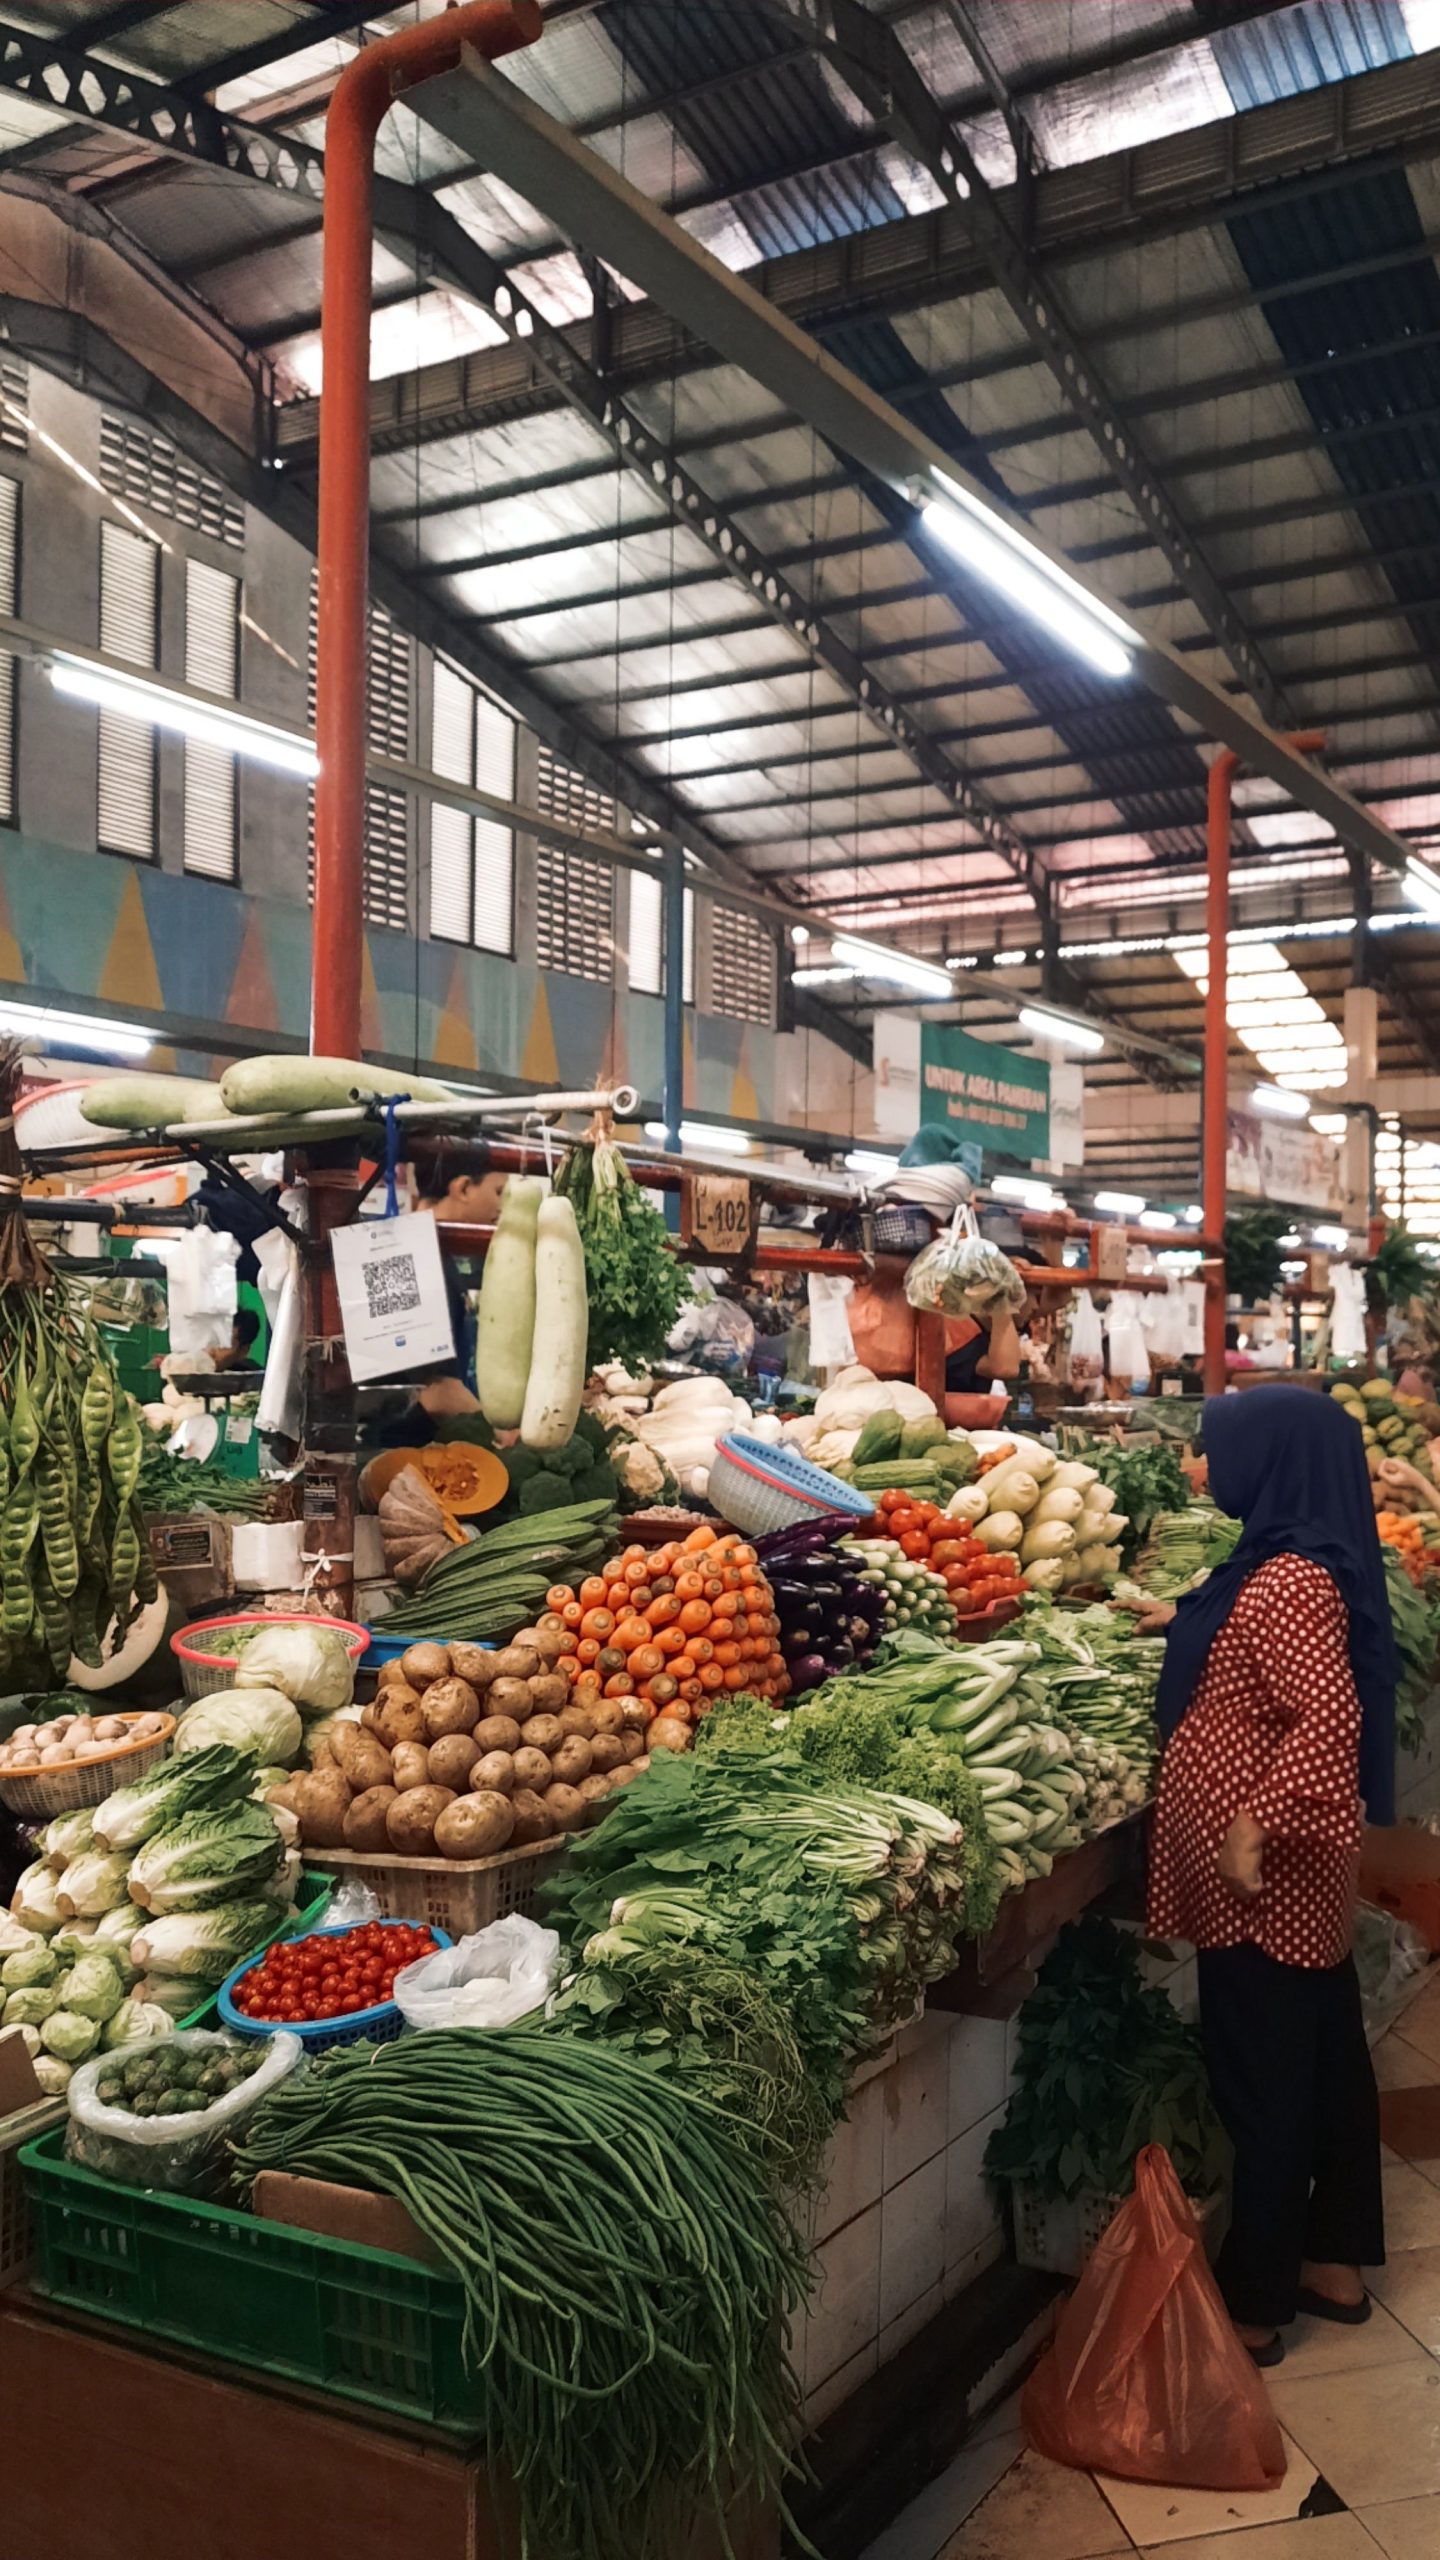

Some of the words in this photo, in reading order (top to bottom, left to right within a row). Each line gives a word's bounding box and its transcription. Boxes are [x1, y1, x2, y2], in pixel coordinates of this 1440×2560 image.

[925, 1064, 965, 1096] UNTUK
[967, 1074, 996, 1102] AREA
[696, 1199, 746, 1232] L-102
